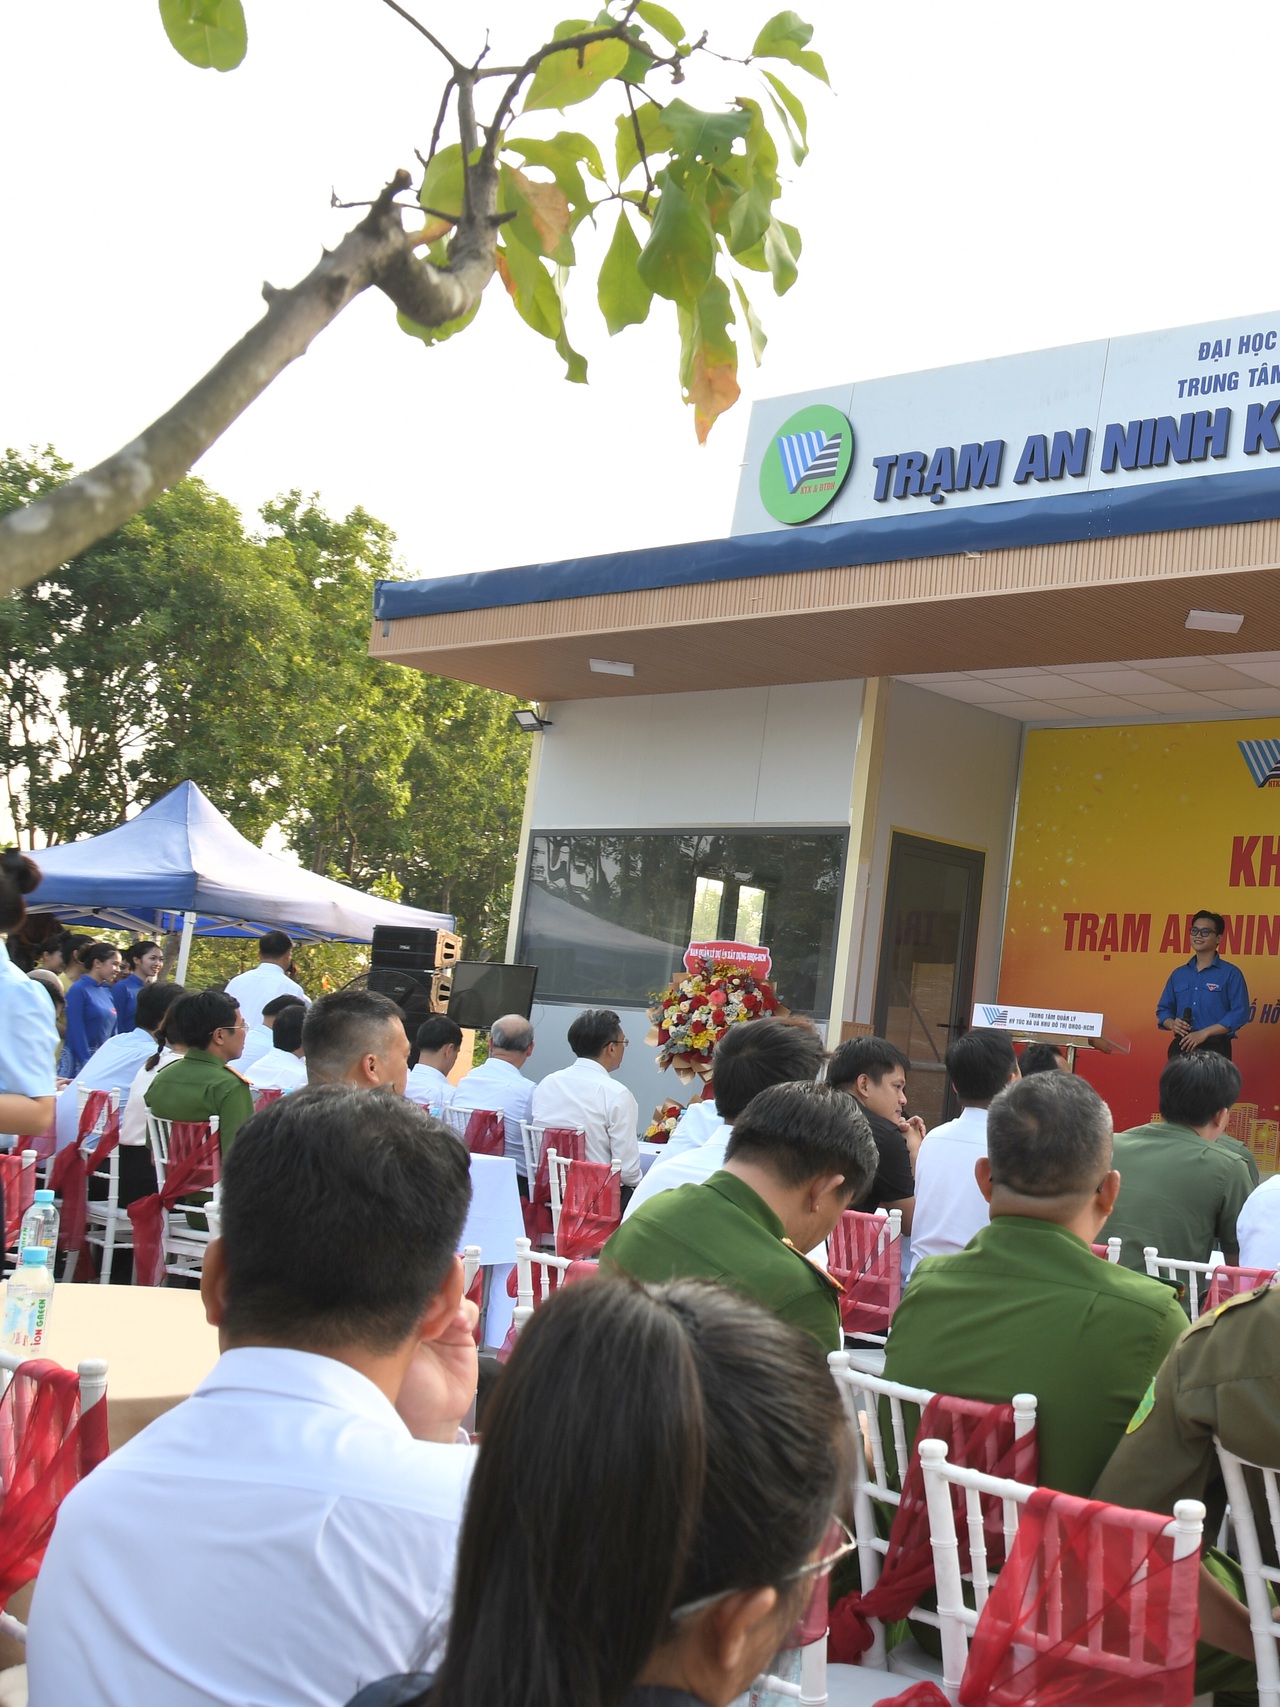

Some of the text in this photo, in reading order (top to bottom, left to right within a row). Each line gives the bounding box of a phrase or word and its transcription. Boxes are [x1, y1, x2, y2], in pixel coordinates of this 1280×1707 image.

[1198, 339, 1231, 362] ĐẠI
[1238, 328, 1277, 356] HỌC
[1177, 371, 1239, 399] TRUNG
[871, 438, 1006, 504] TRẠM
[1014, 426, 1091, 484] AN
[1100, 406, 1232, 474] NINH
[1063, 912, 1152, 962] TRẠM
[36, 1299, 46, 1327] GREEN
